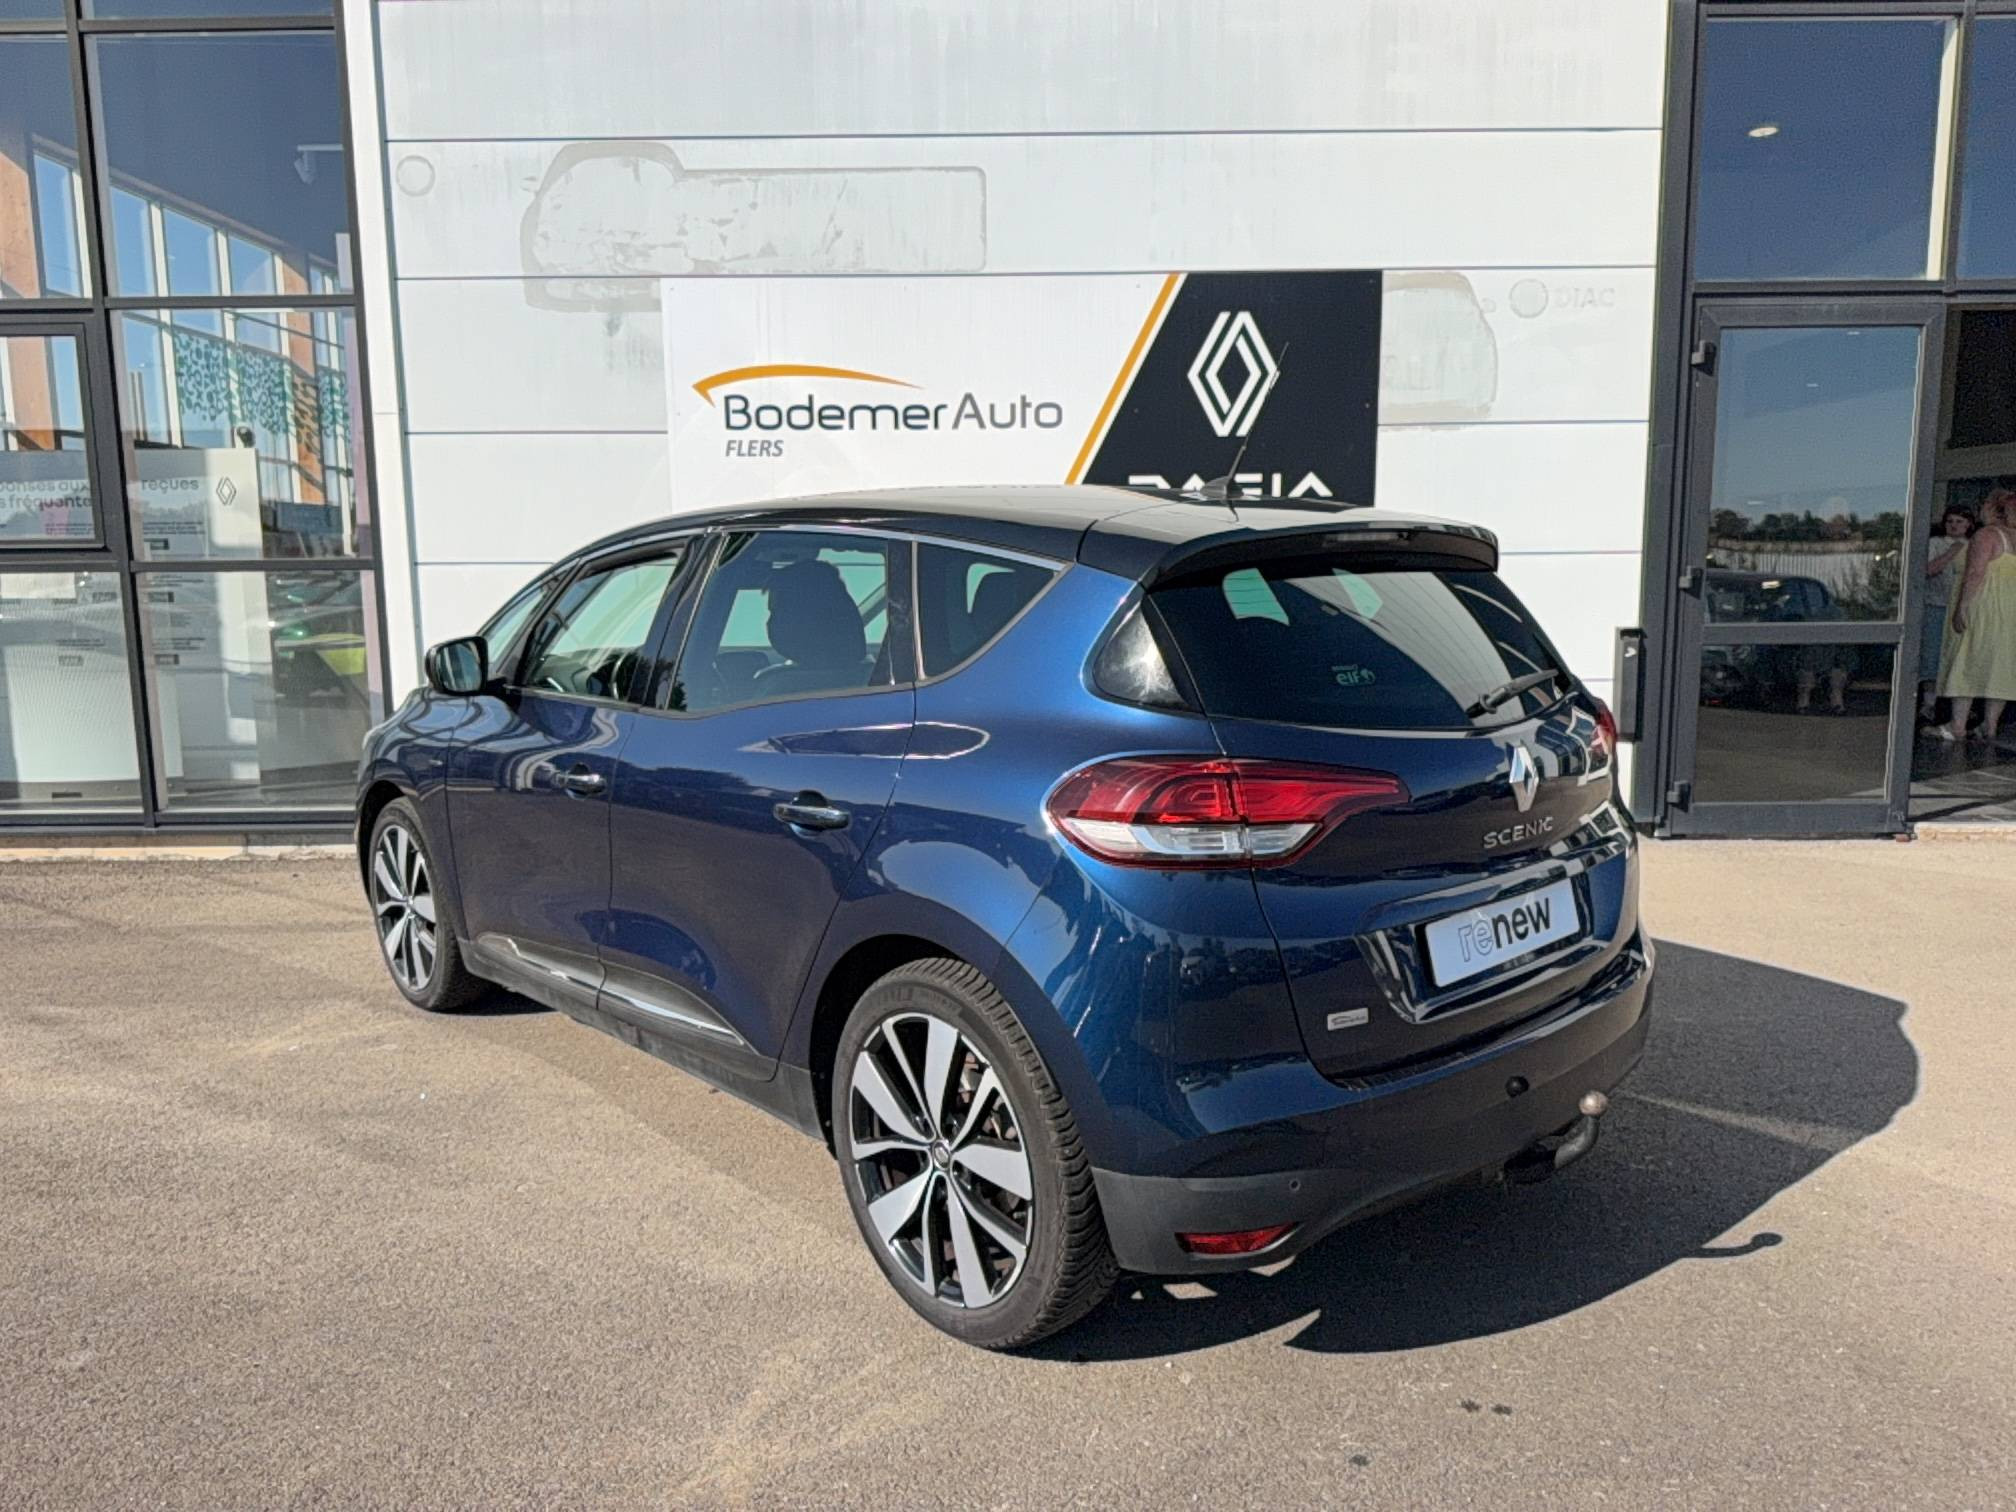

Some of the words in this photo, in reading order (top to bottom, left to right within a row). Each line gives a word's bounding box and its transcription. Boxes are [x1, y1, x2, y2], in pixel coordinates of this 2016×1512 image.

[723, 392, 1063, 431] BodemerAuto
[725, 439, 784, 457] FLERS
[141, 479, 200, 494] reçues
[1483, 816, 1553, 848] SCENIC
[1458, 897, 1551, 963] renew
